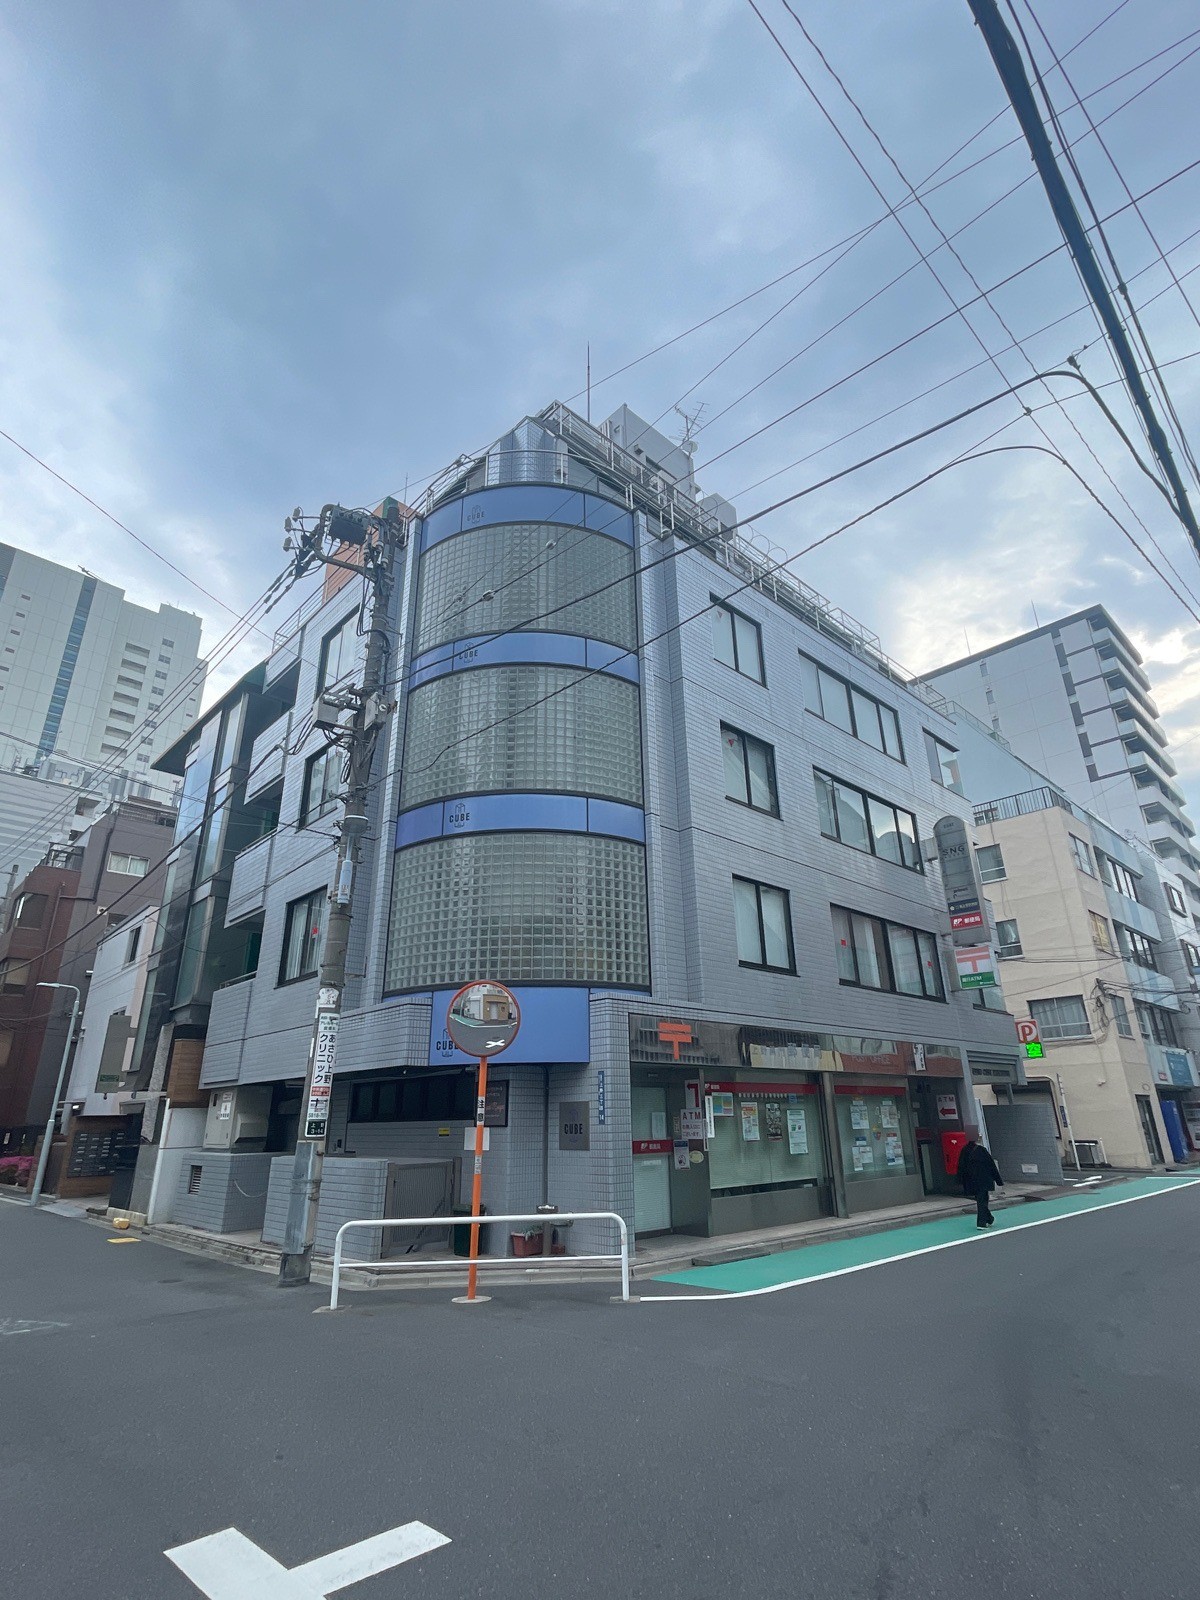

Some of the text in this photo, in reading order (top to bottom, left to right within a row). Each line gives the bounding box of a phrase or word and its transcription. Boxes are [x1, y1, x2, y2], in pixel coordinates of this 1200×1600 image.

[467, 511, 485, 521] CUBE
[459, 649, 478, 660] CUBE
[449, 812, 470, 823] CUBE
[942, 845, 965, 856] SNG
[1018, 1022, 1037, 1042] P
[314, 1033, 328, 1084] クリニック
[324, 1034, 336, 1084] あさひ上野
[682, 1112, 701, 1120] ATM
[564, 1123, 583, 1135] CUBE
